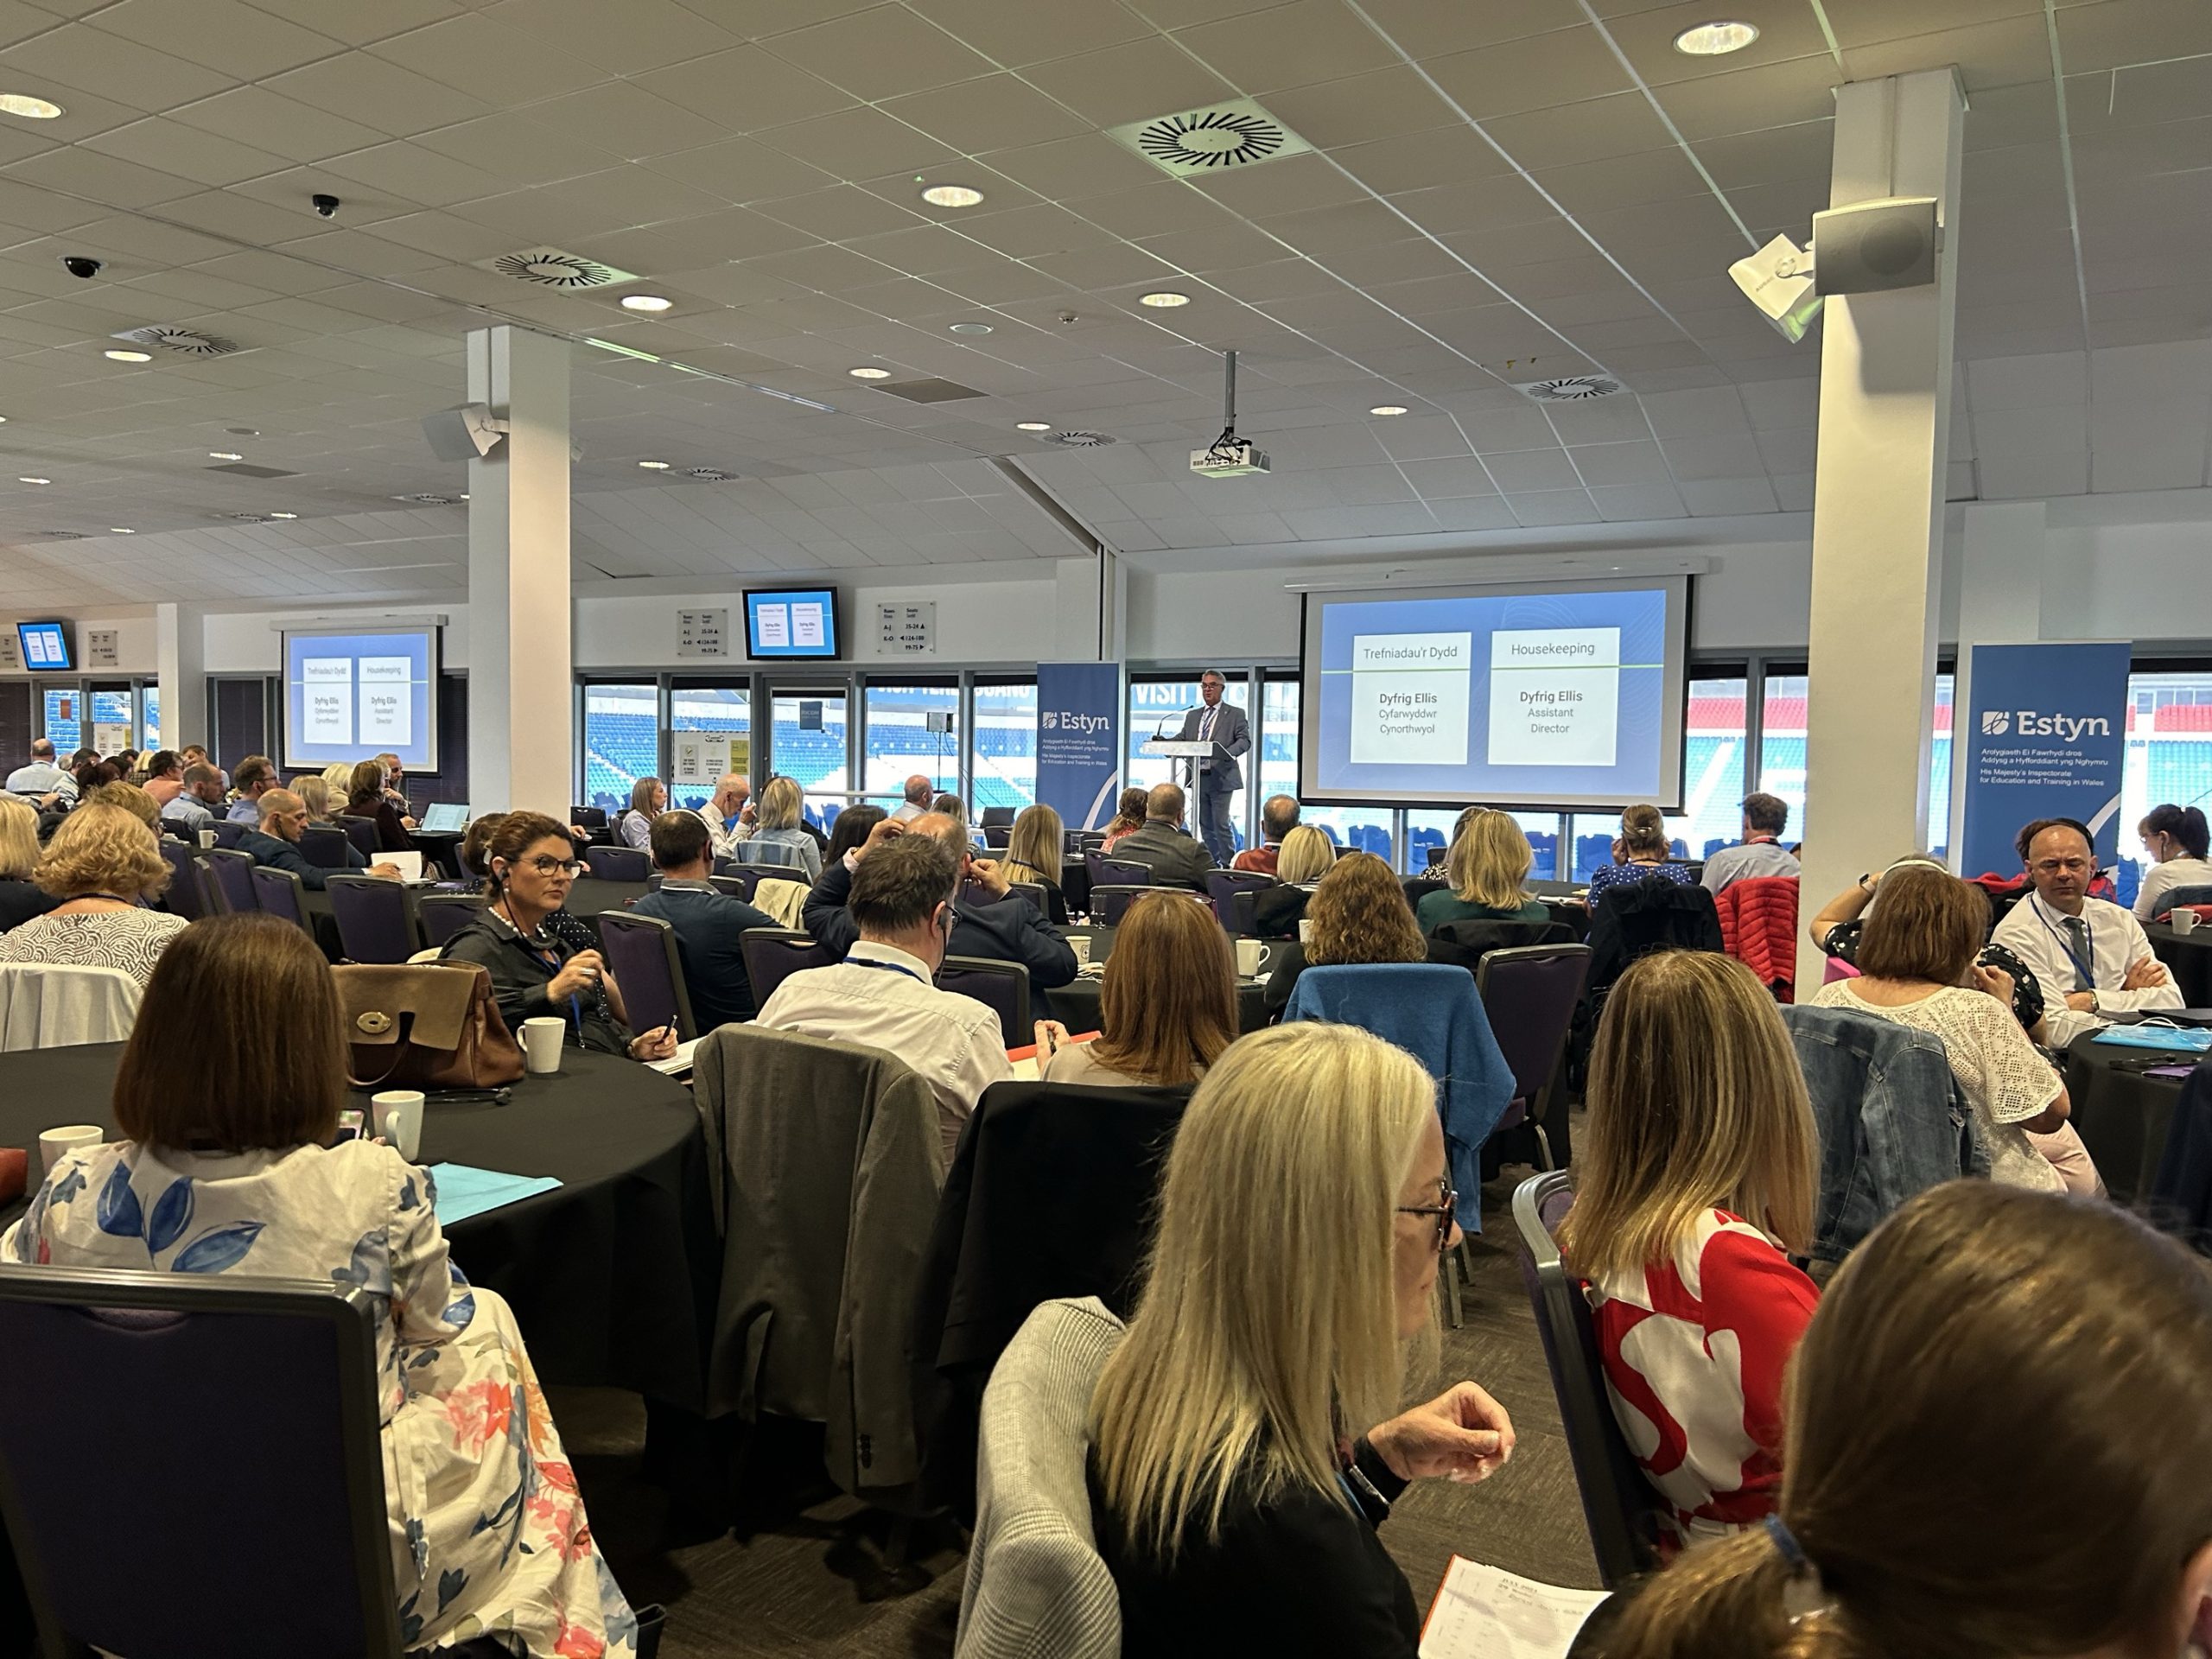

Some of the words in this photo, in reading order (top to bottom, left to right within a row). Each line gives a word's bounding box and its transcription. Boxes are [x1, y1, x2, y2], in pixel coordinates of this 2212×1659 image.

[1363, 646, 1427, 659] Trefniadau'r
[1430, 646, 1458, 660] Dydd
[1511, 643, 1595, 656] Housekeeping
[367, 667, 401, 676] Housekeeping
[1136, 684, 1187, 704] VISIT
[1379, 693, 1412, 706] Dyfrig
[1415, 693, 1438, 703] Ellis
[1520, 691, 1555, 704] Dyfrig
[1558, 690, 1583, 702] Ellis
[1379, 709, 1437, 720] Cyfarwyddwr
[1527, 708, 1574, 717] Assistant
[1061, 712, 1109, 734] Estyn
[1531, 724, 1570, 733] Director
[2017, 711, 2110, 742] Estyn
[1380, 724, 1435, 735] Cynorthwyol
[1994, 769, 2026, 777] Majesty's
[2043, 778, 2071, 786] Training
